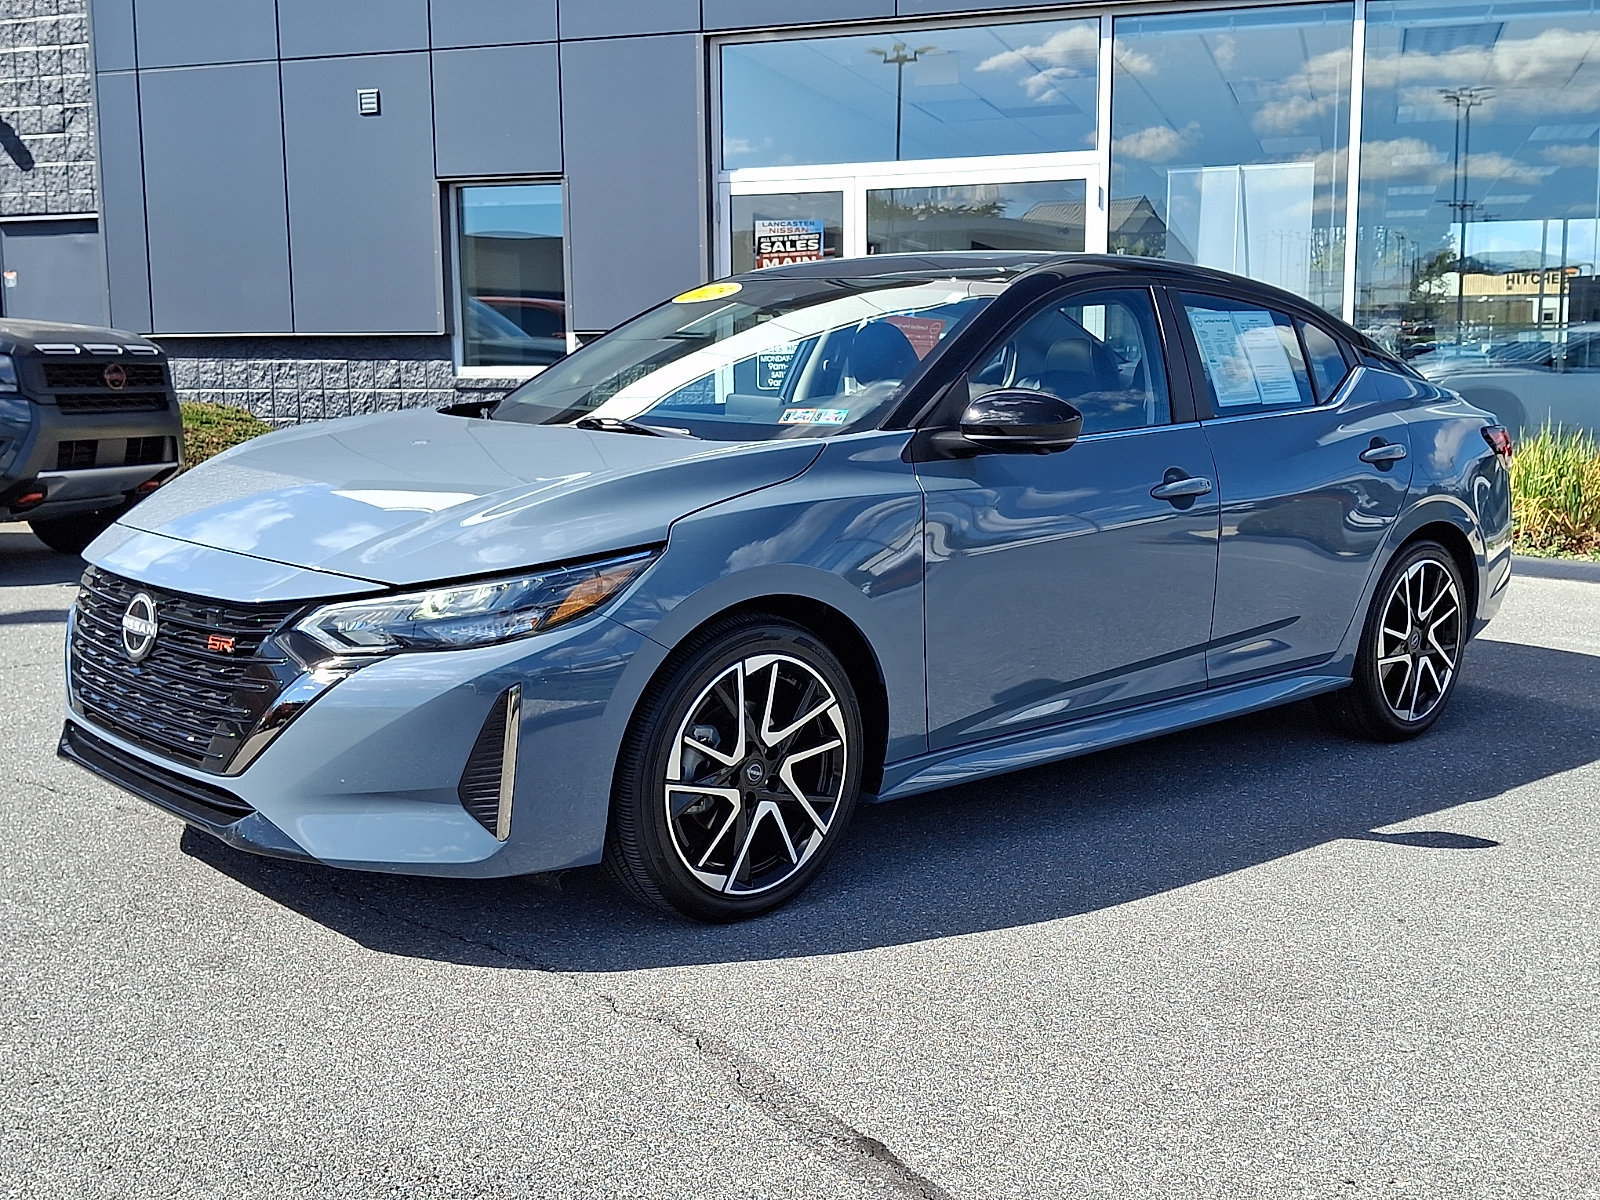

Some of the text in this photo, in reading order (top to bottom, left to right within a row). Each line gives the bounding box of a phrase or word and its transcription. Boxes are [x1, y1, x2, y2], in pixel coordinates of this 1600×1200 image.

[760, 240, 819, 252] SALES
[1506, 273, 1560, 284] HITCHE
[123, 615, 156, 636] NISSAN
[208, 635, 234, 652] SR
